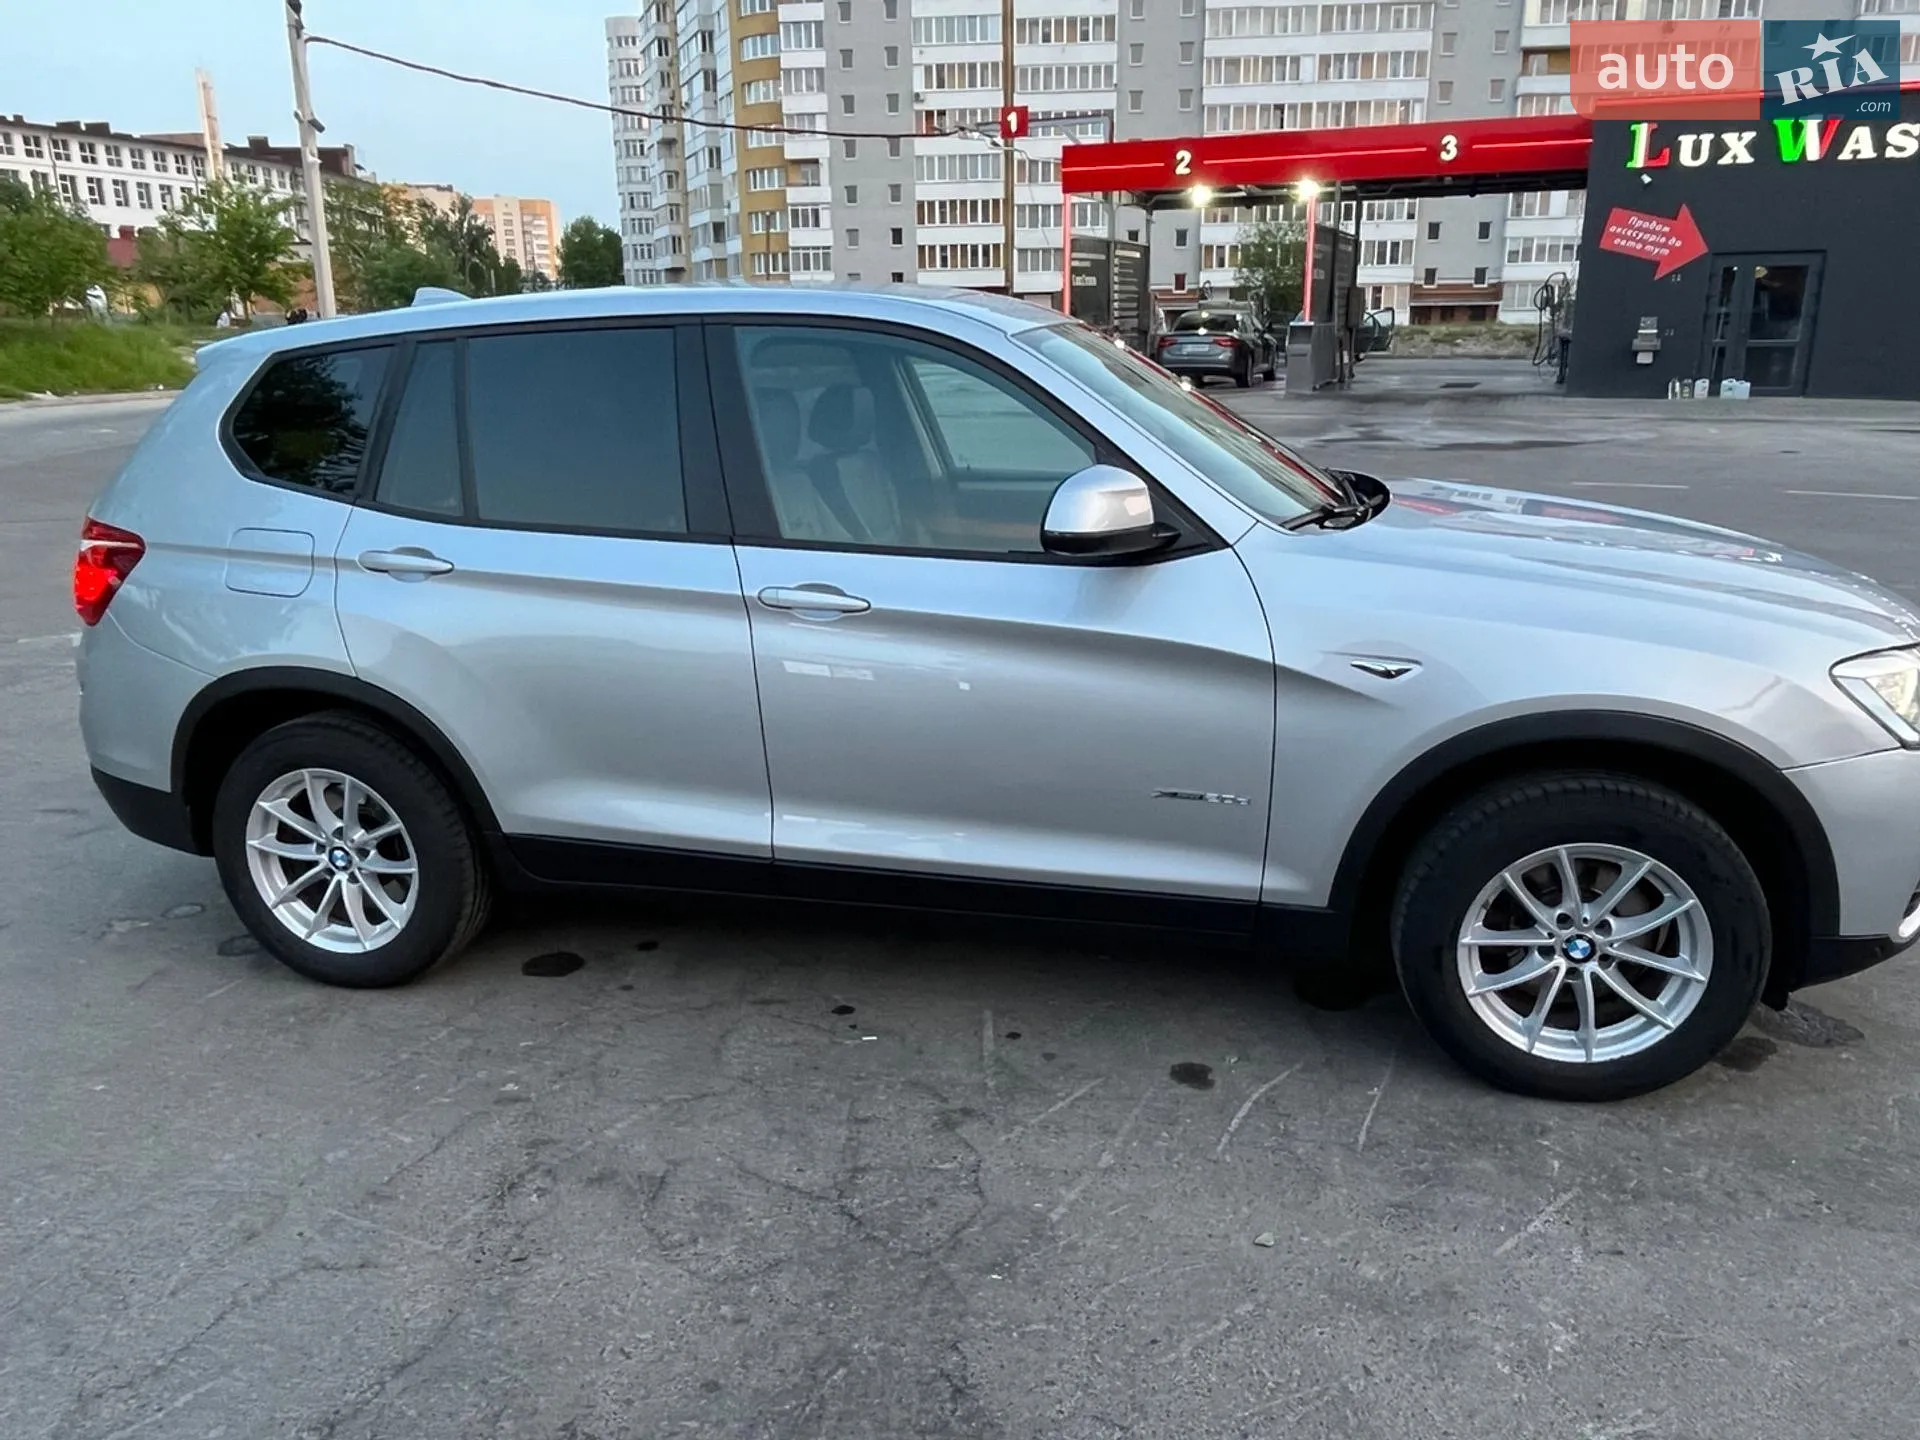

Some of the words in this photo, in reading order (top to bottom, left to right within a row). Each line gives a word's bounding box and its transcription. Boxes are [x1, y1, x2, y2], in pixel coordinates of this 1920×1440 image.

[1007, 111, 1018, 133] 1
[1440, 134, 1457, 161] 3
[1626, 122, 1757, 168] LUX
[1175, 150, 1191, 175] 2
